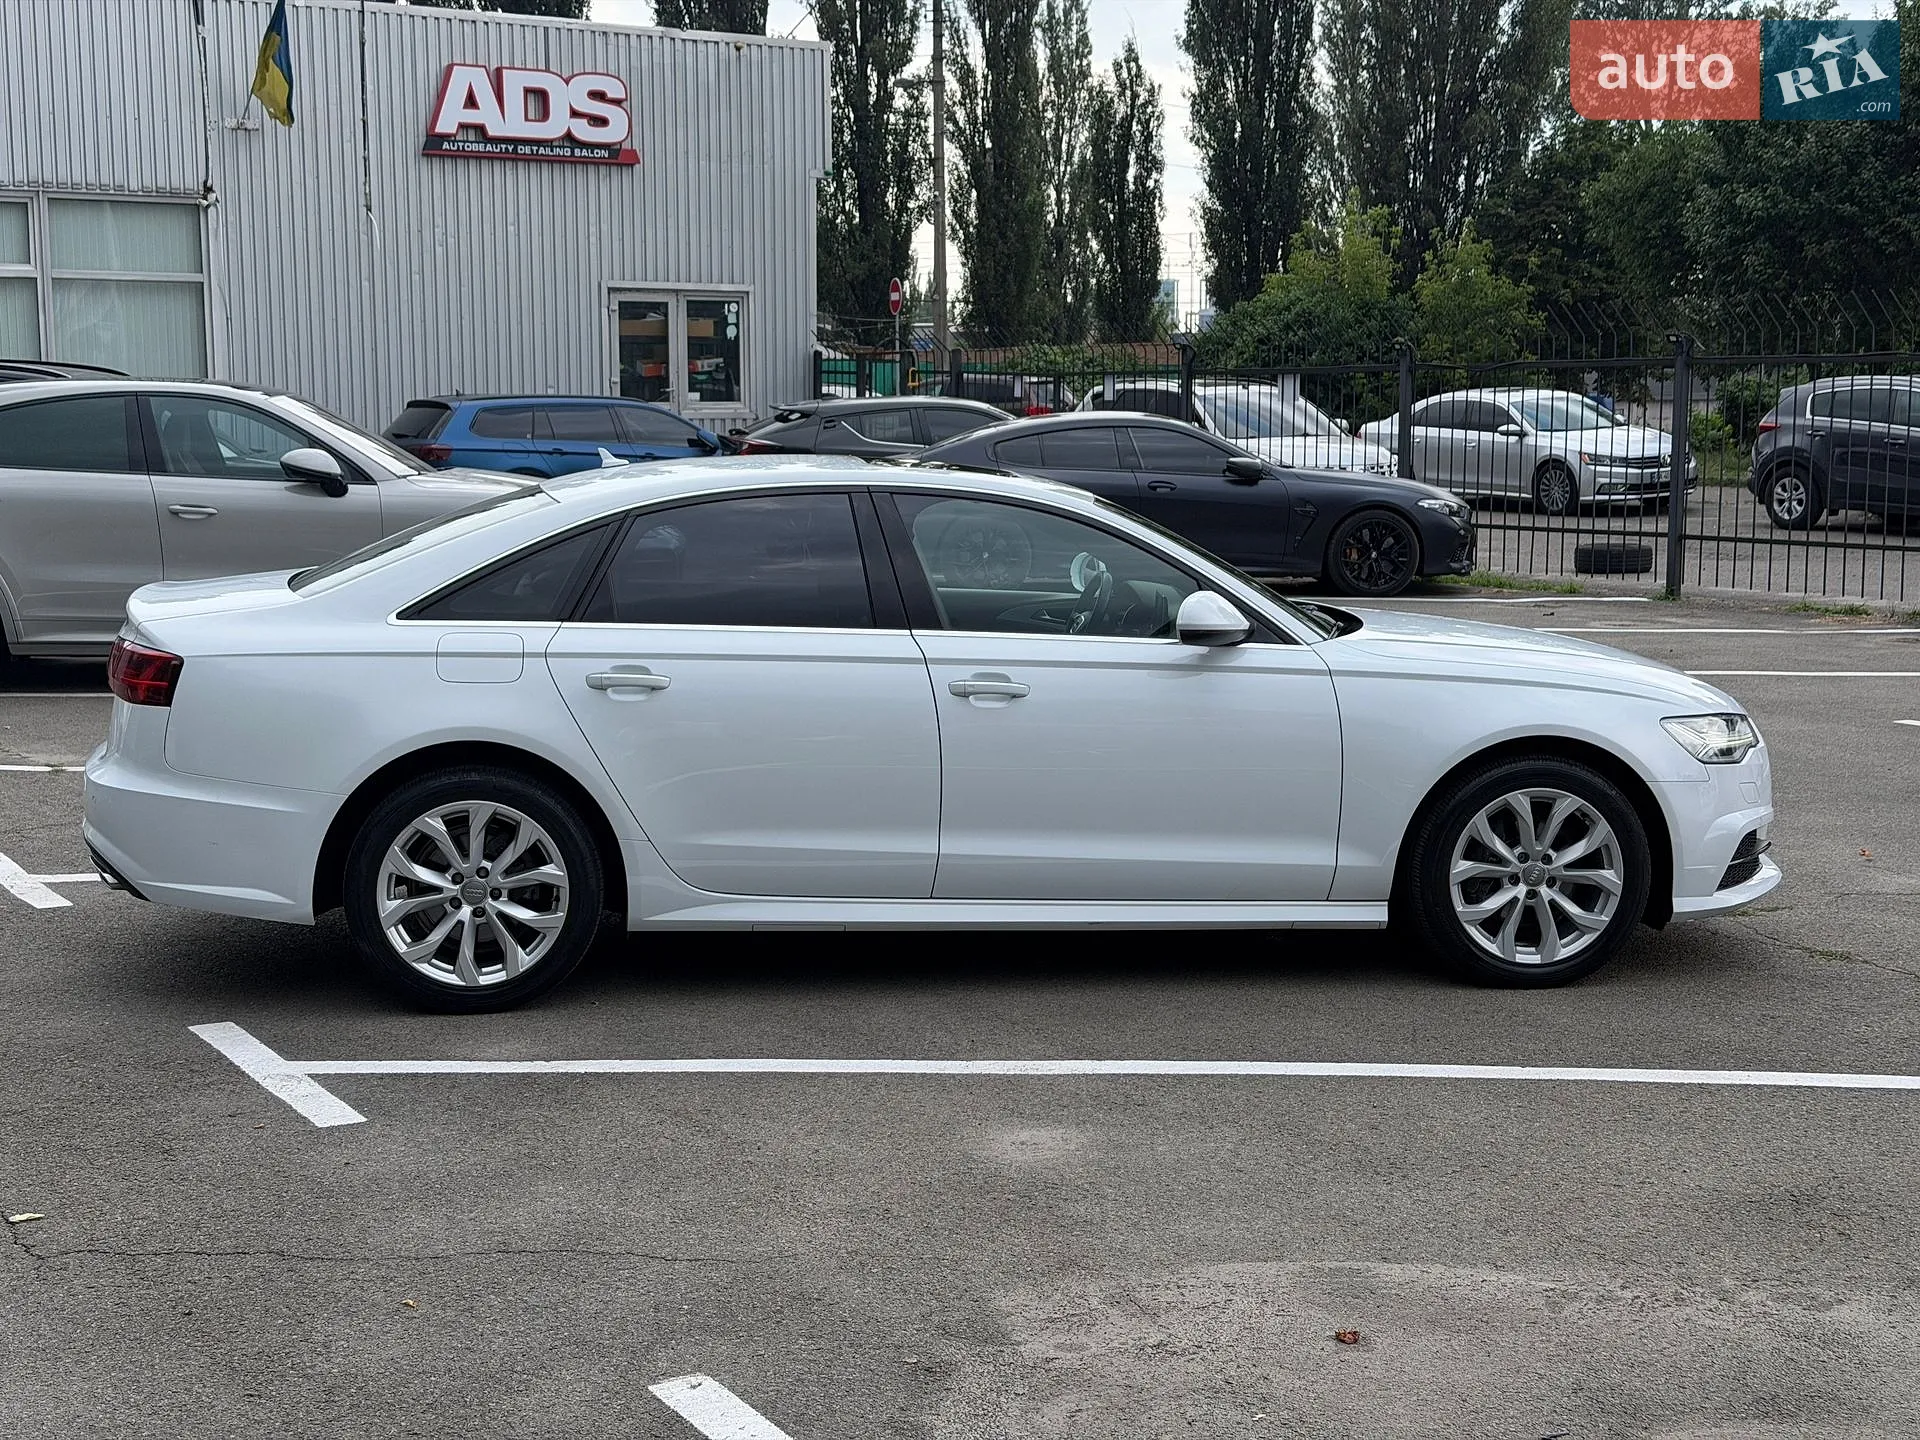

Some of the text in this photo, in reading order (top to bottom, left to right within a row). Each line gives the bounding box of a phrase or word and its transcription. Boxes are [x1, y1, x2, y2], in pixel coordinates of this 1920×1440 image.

[433, 64, 630, 144] ADS
[442, 141, 609, 158] AUTOBEAUTY DETAILING SALON
